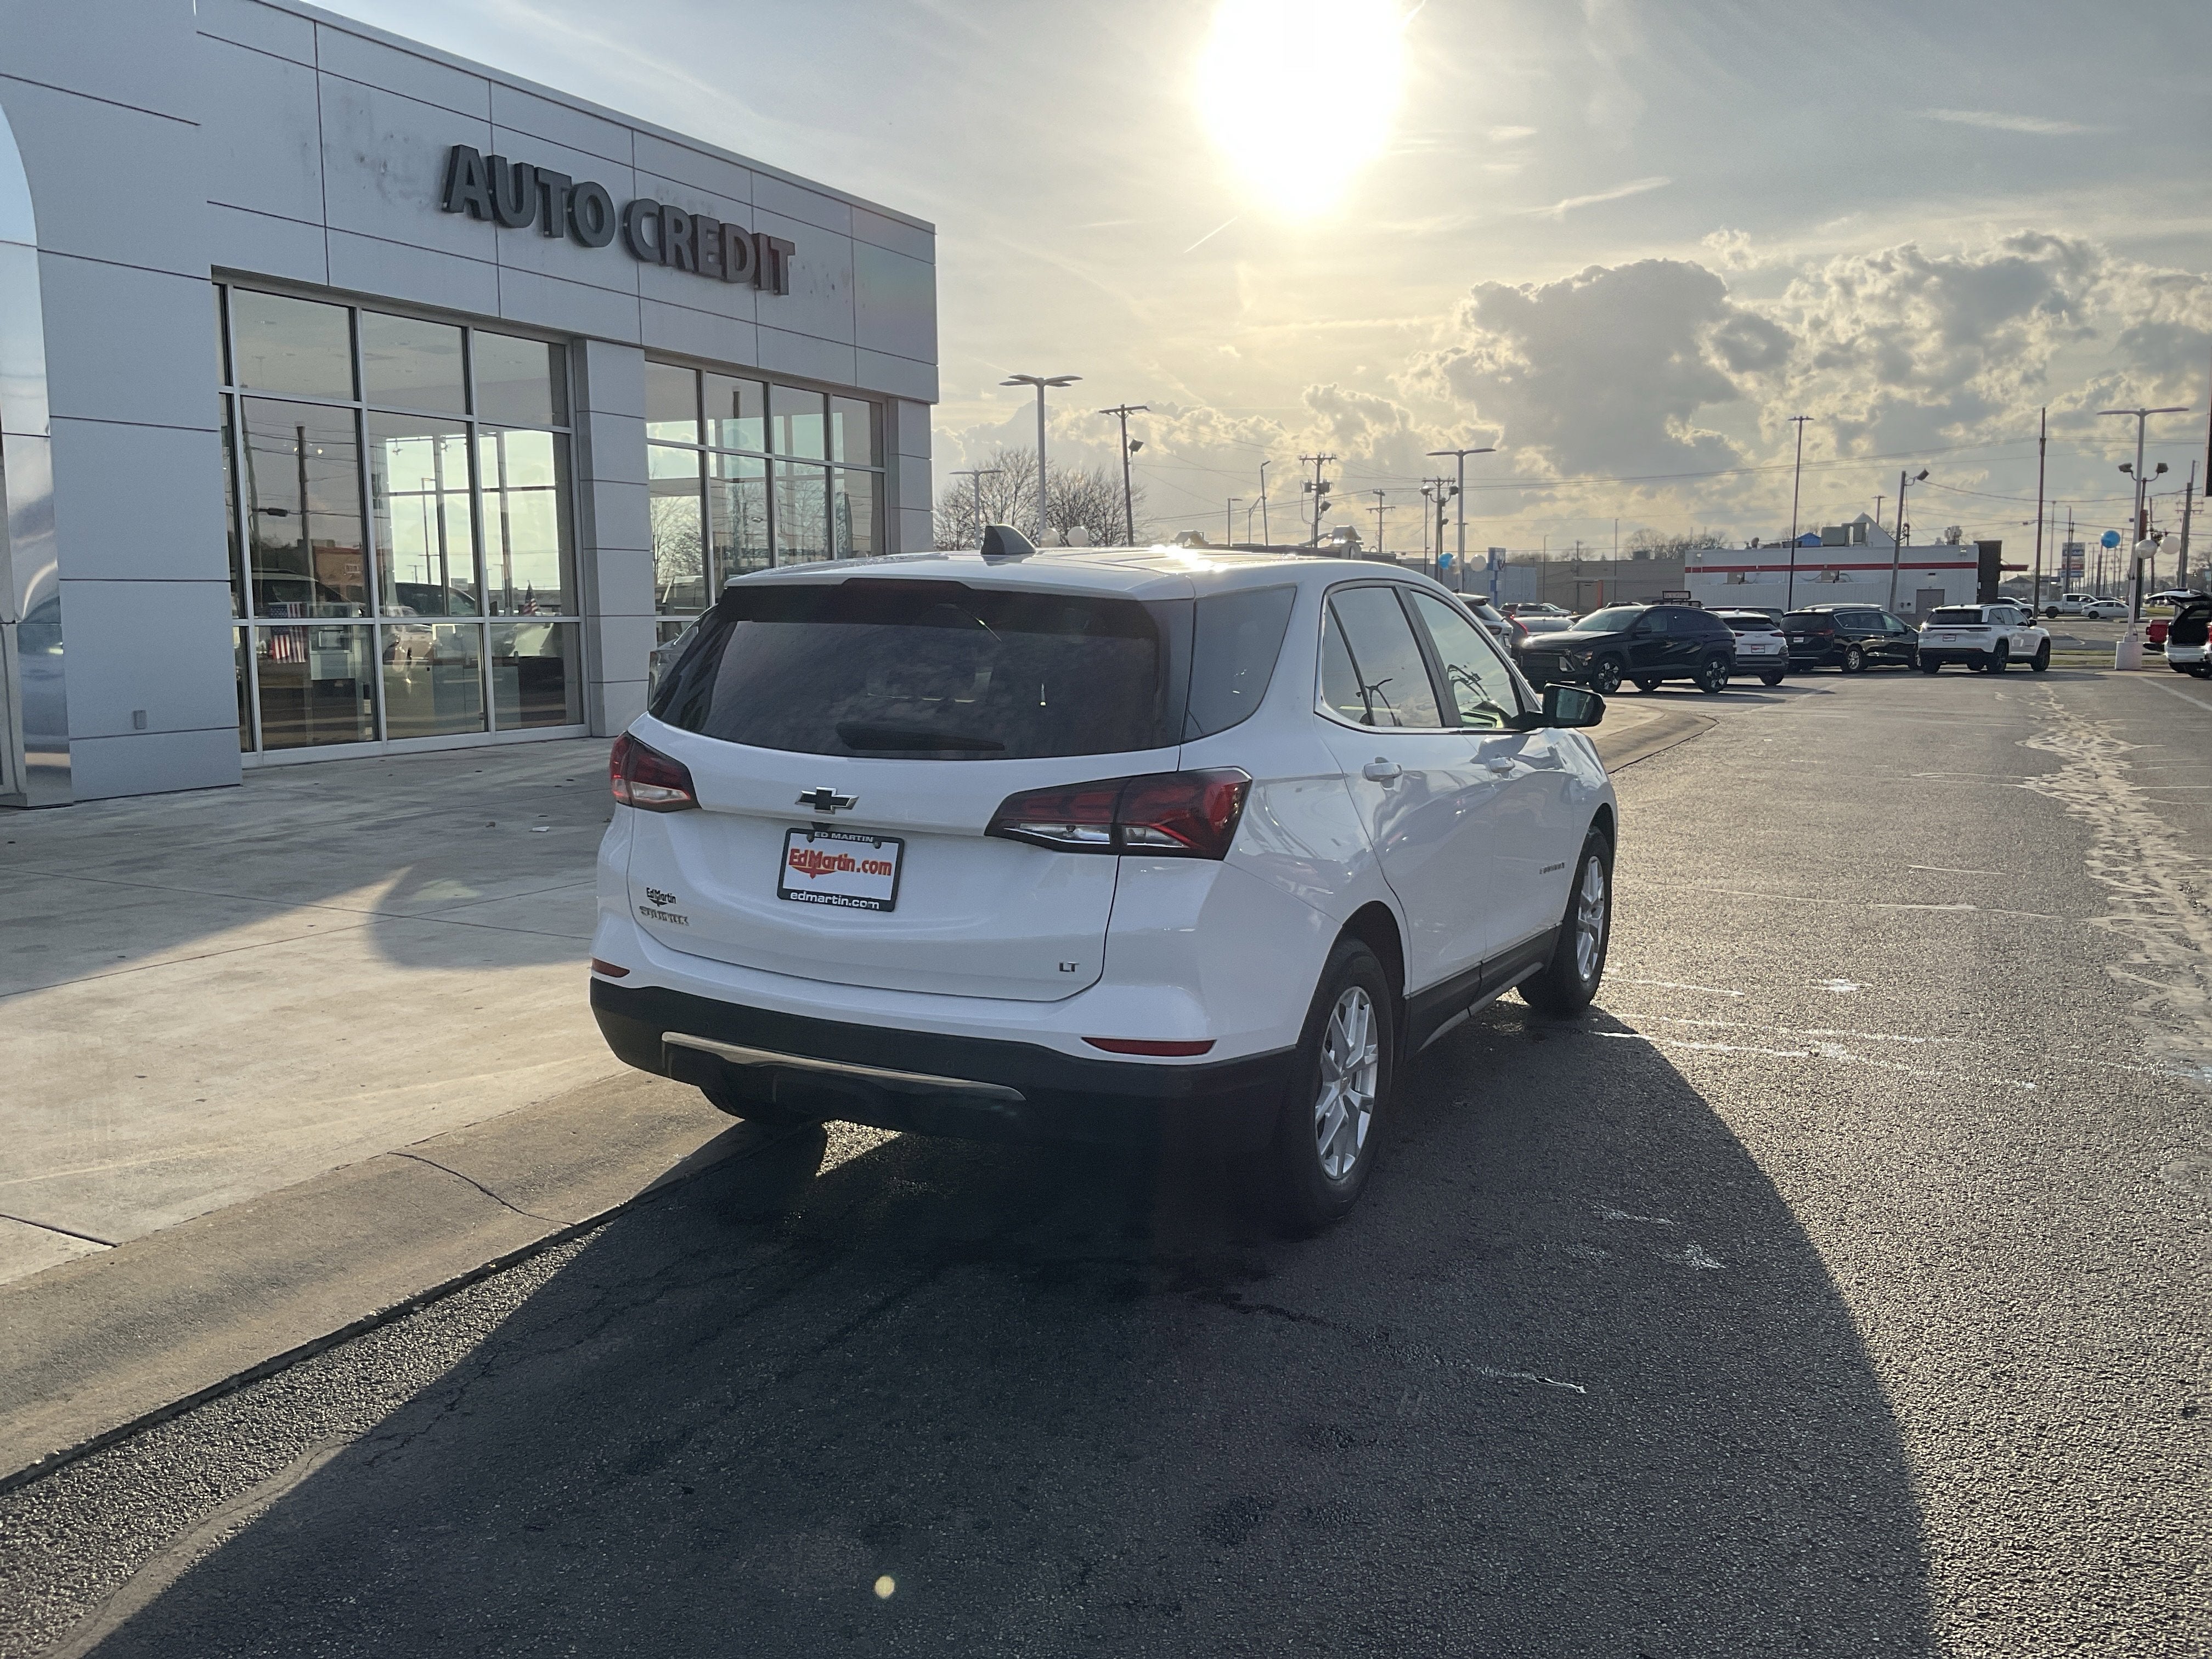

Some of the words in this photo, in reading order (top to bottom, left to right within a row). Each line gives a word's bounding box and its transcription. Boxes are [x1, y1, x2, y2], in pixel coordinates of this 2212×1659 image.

[442, 144, 615, 247] AUTO
[623, 198, 795, 295] CREDIT
[831, 833, 874, 842] MARTIN
[789, 848, 892, 877] EdMartin.com
[790, 891, 879, 909] edmartin.com
[1059, 961, 1080, 972] LT
